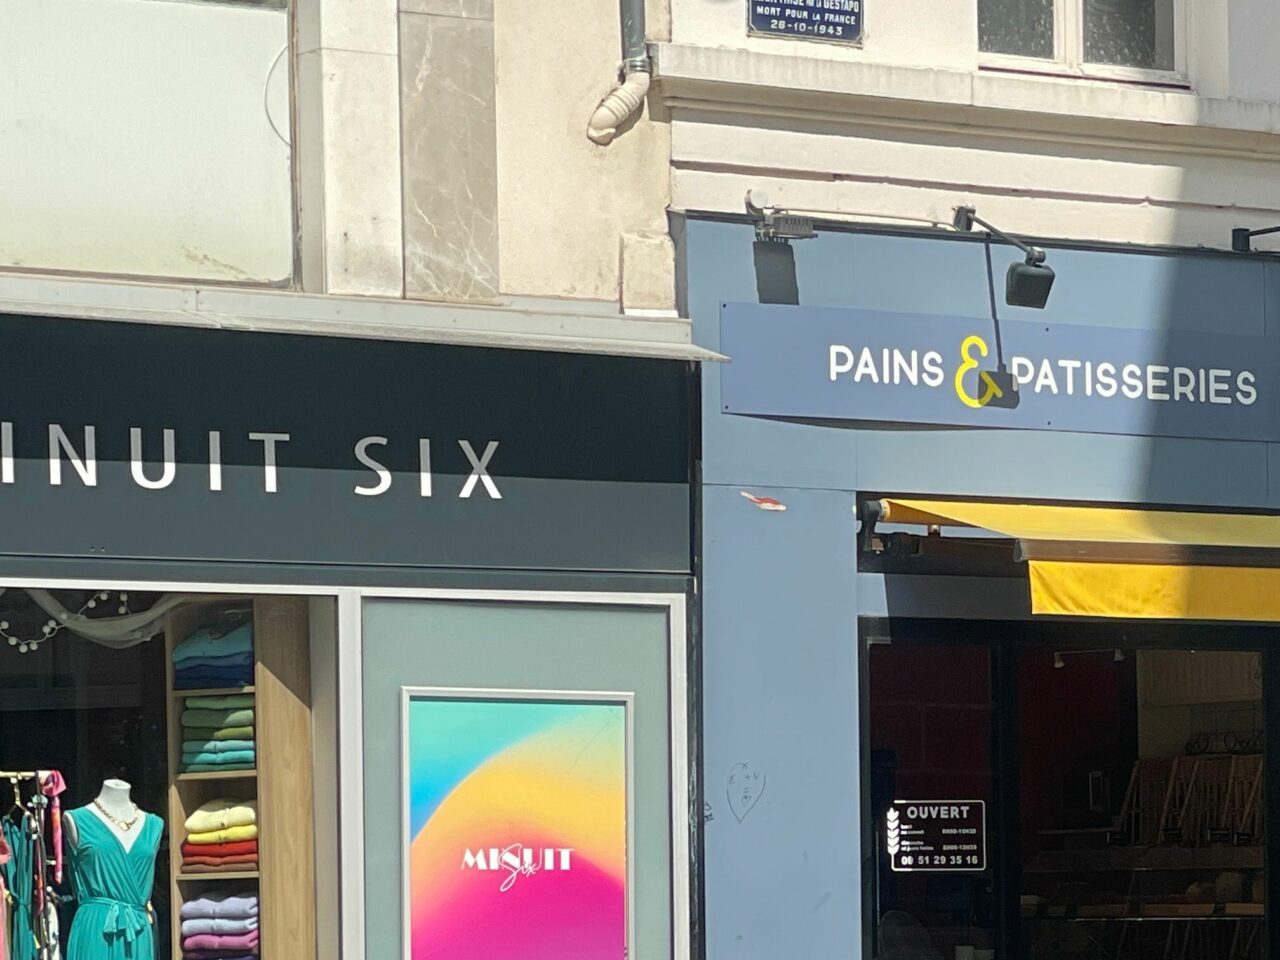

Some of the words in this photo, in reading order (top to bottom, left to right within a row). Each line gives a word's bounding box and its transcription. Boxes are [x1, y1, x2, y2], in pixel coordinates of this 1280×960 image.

[756, 5, 781, 16] MORT
[785, 9, 808, 19] POUR
[812, 13, 821, 21] LA
[825, 13, 856, 25] FRANCE
[824, 0, 859, 12] GESTAPO
[829, 345, 944, 387] PAINS
[955, 335, 1003, 409] &
[1012, 357, 1258, 406] PATISSERIES
[353, 435, 503, 499] SIX
[906, 806, 970, 819] OUVERT
[461, 847, 576, 871] MINUIT
